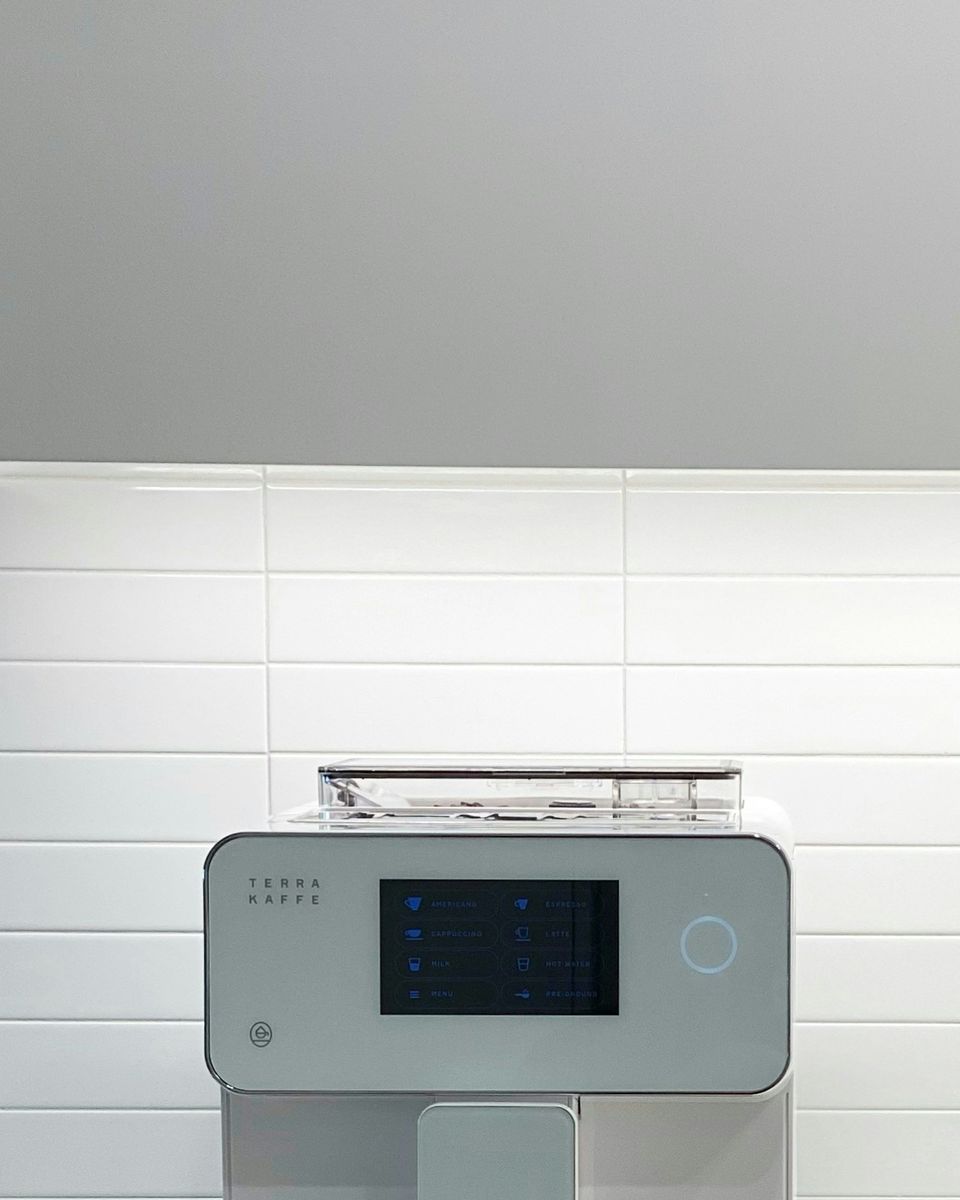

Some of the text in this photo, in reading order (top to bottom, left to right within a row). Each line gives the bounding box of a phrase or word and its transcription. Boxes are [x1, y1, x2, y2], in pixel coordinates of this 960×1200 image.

[248, 877, 320, 889] TERRA
[248, 894, 320, 905] KAFFE
[431, 959, 450, 968] MILK
[431, 990, 454, 998] MENU
